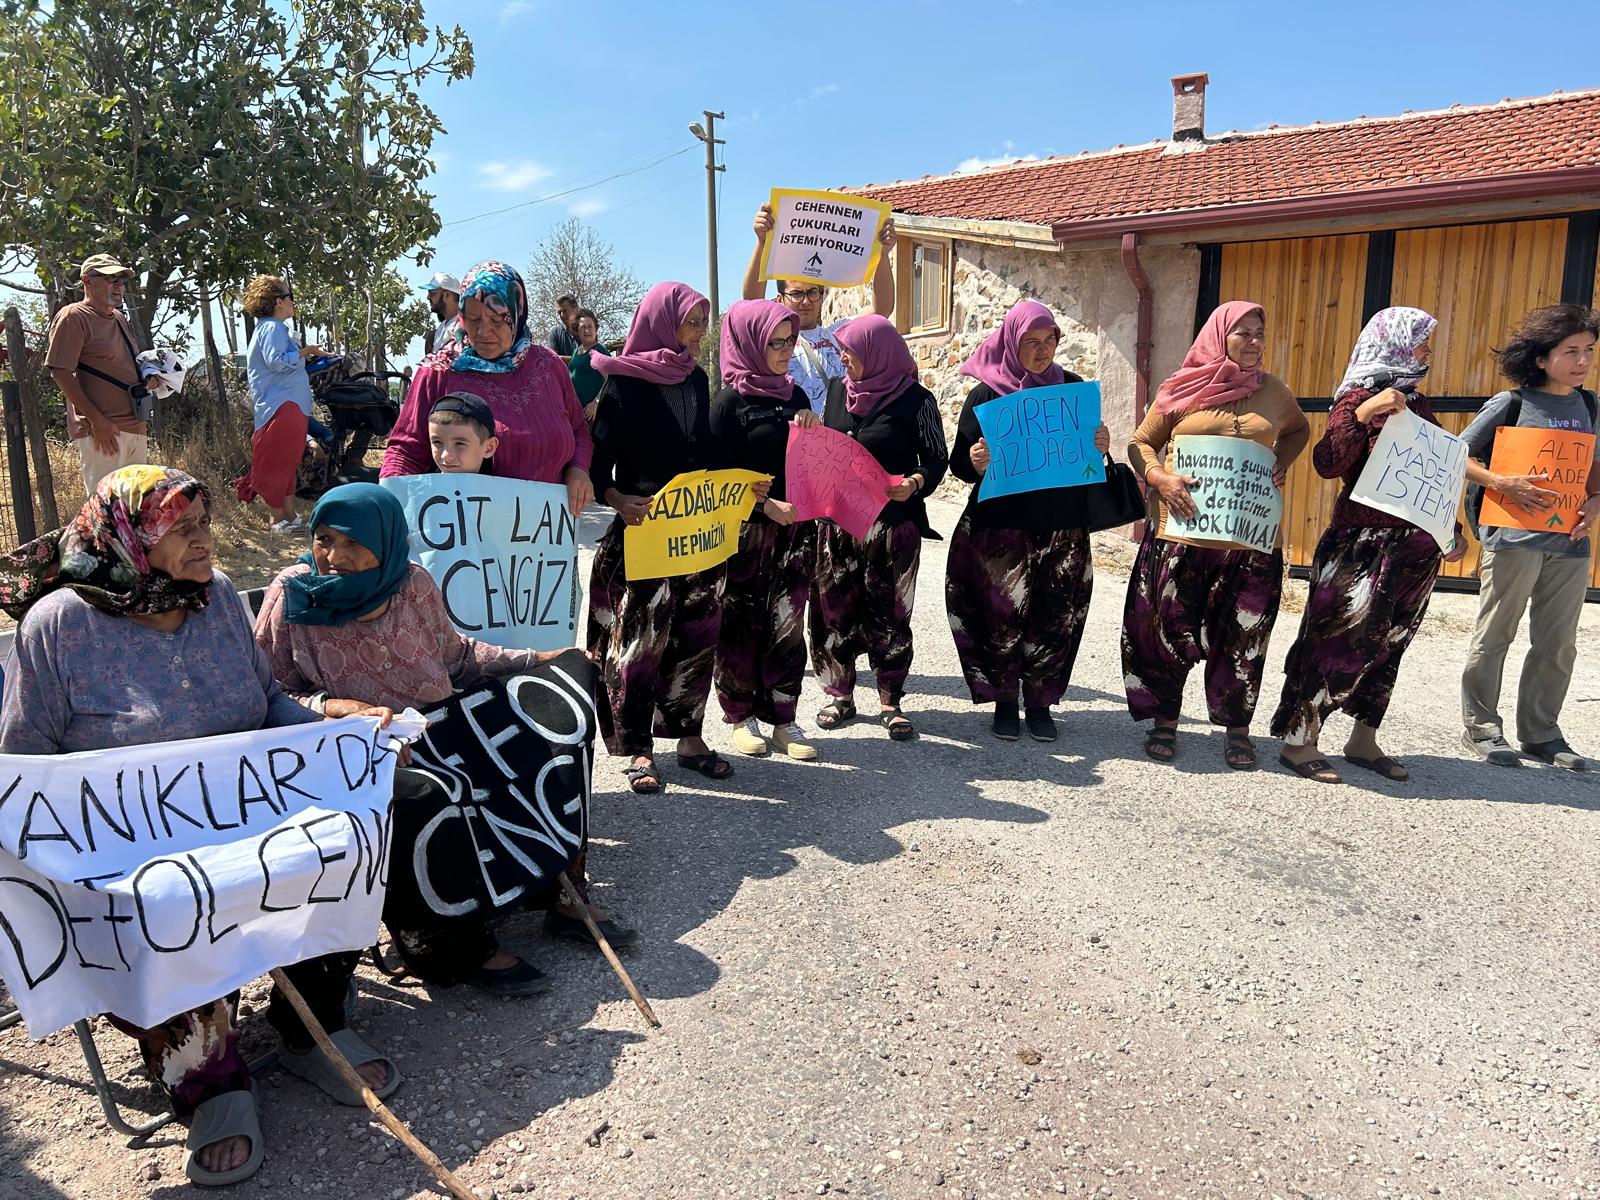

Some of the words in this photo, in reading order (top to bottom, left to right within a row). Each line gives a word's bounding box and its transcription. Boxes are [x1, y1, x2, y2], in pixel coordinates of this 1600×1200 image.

[795, 201, 863, 220] CEHENNEM
[790, 218, 861, 238] ÇUKURLARI
[780, 233, 865, 256] İSTEMİYORUZ!
[1548, 417, 1569, 428] Live
[990, 433, 1085, 481] AZDAĞI
[418, 490, 492, 551] GİT
[510, 496, 577, 546] LAN
[441, 552, 578, 632] CENGİZ!
